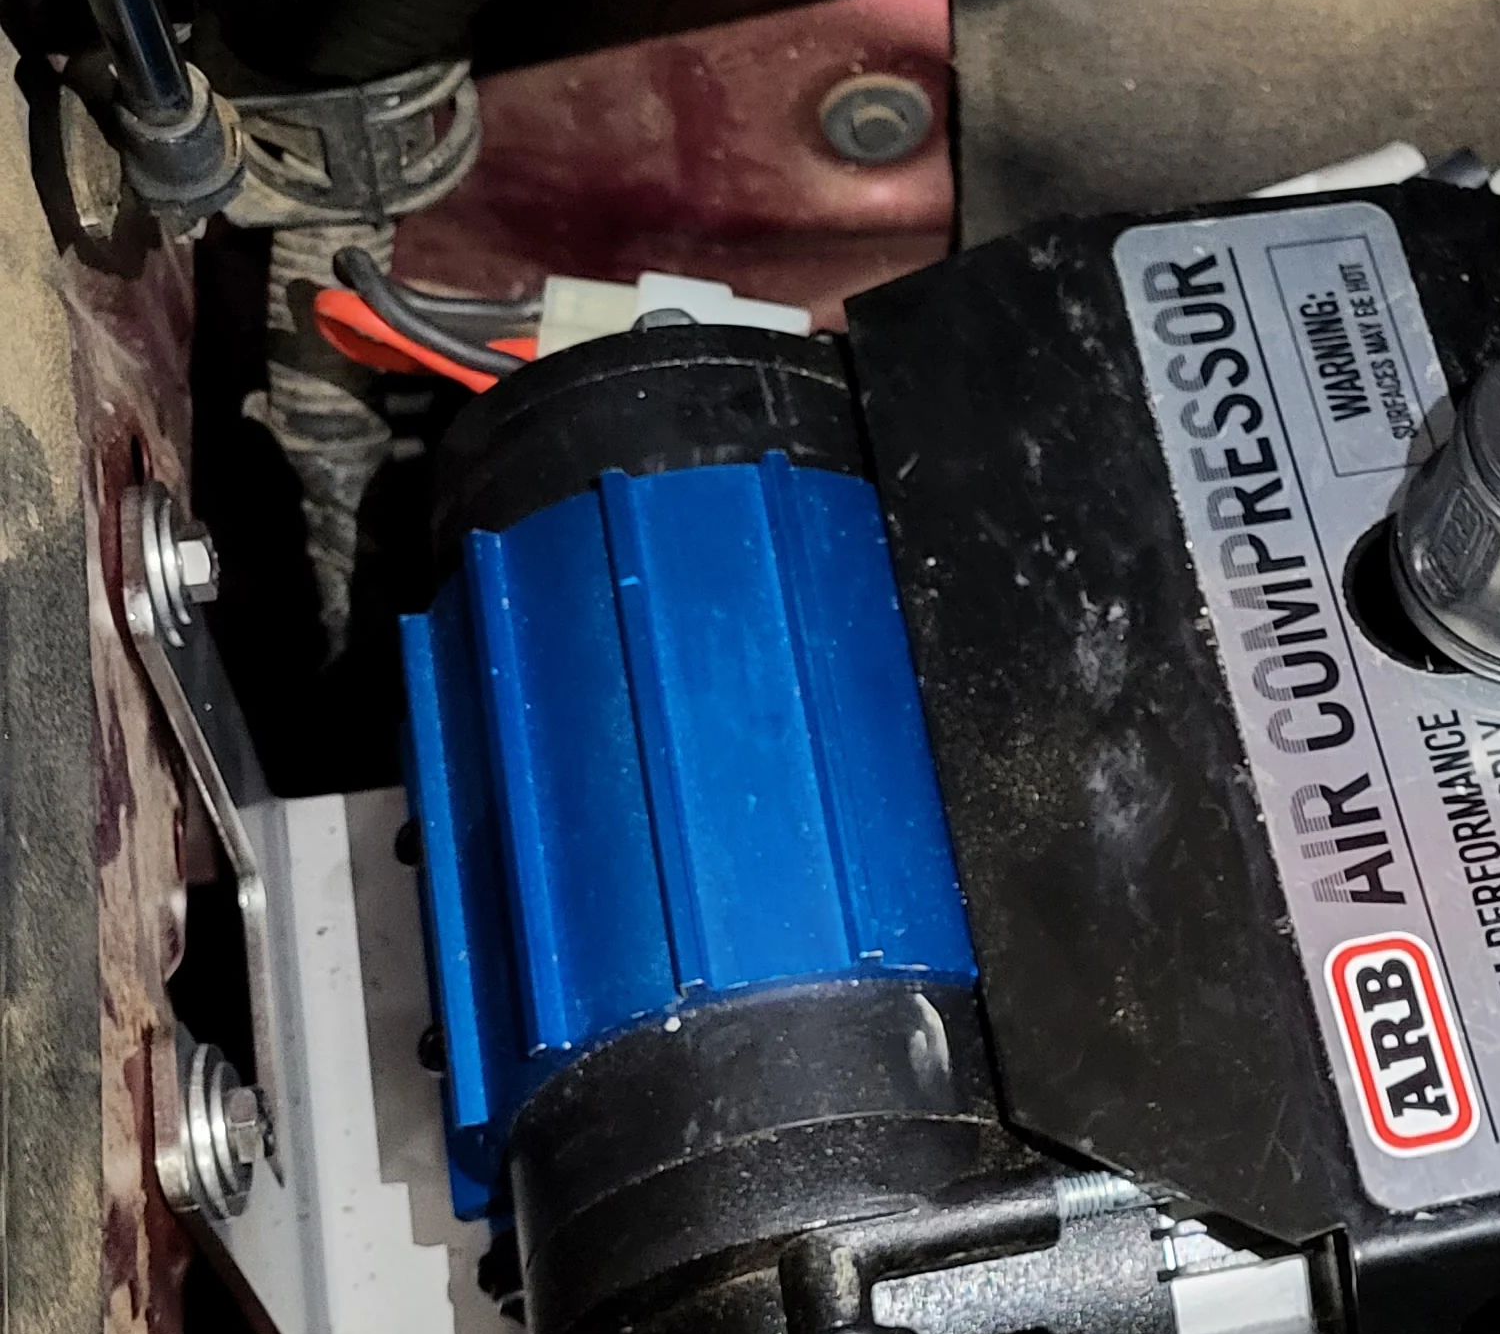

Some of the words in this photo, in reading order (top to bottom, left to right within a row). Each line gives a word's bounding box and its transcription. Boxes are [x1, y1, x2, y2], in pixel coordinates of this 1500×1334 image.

[1339, 264, 1370, 292] HOT
[1350, 295, 1379, 318] BE
[1300, 291, 1371, 422] WARNING:
[1358, 322, 1390, 355] MAY
[1371, 359, 1419, 440] SURFACES
[1142, 254, 1355, 753] COMPRESSOR
[1289, 773, 1407, 905] AIR
[1355, 958, 1452, 1118] ARB
